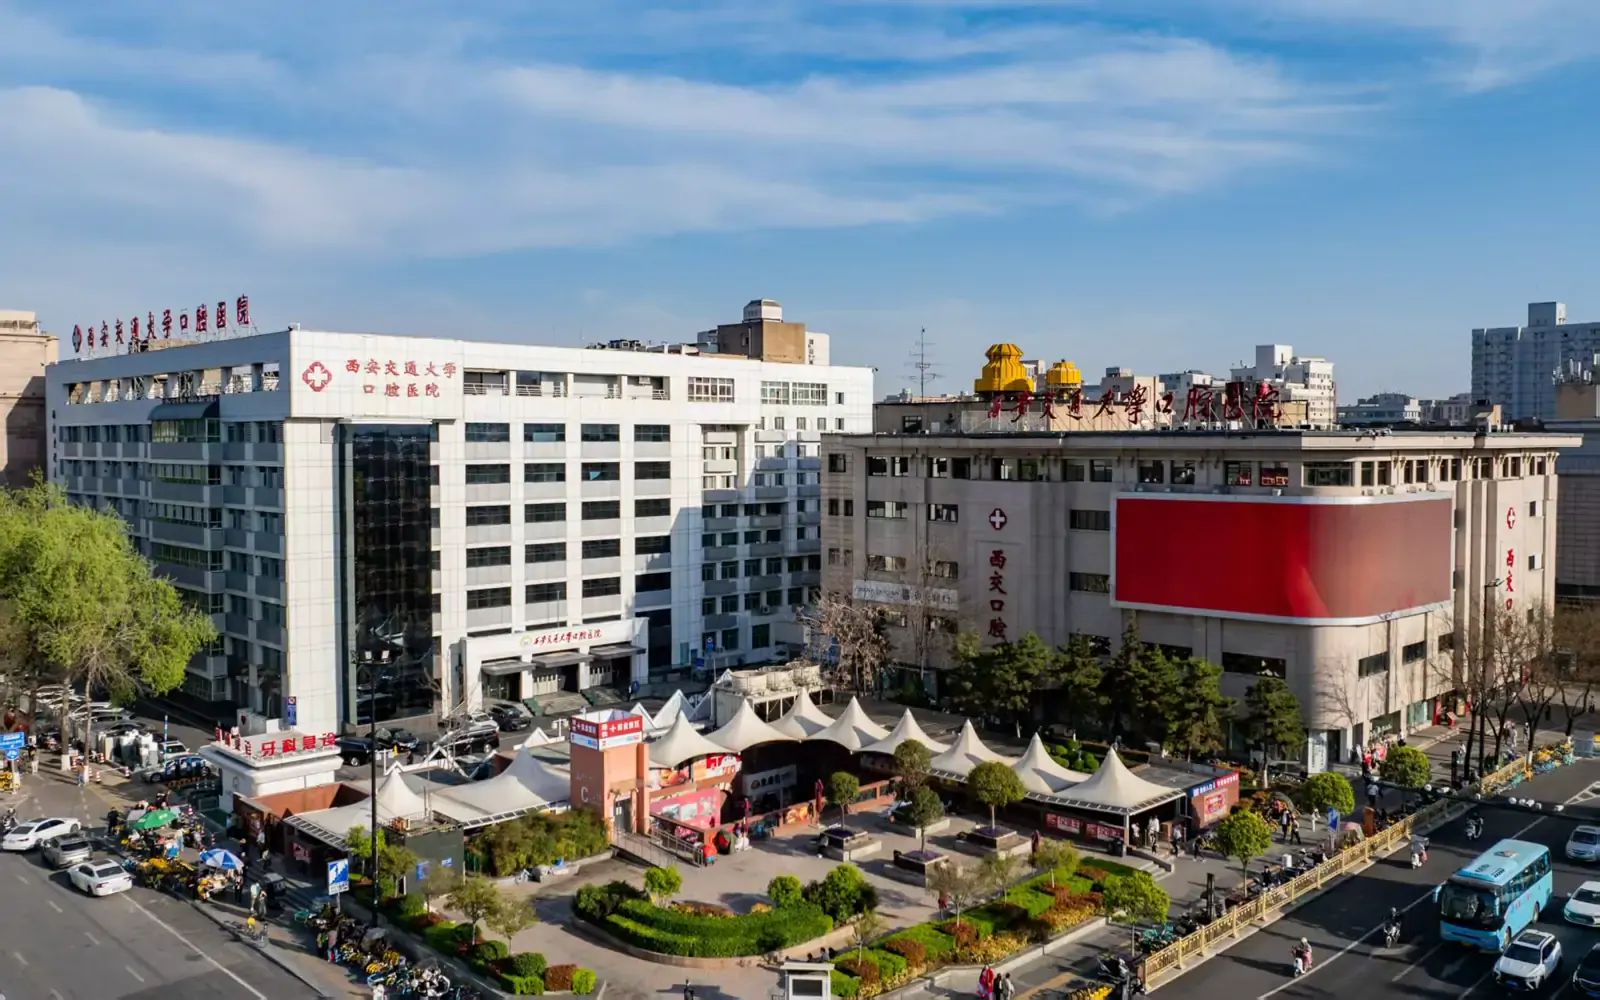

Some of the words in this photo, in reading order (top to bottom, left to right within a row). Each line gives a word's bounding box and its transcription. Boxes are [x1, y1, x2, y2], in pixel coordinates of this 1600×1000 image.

[363, 382, 440, 398] 口腔医院
[261, 732, 337, 757] 牙科急诊
